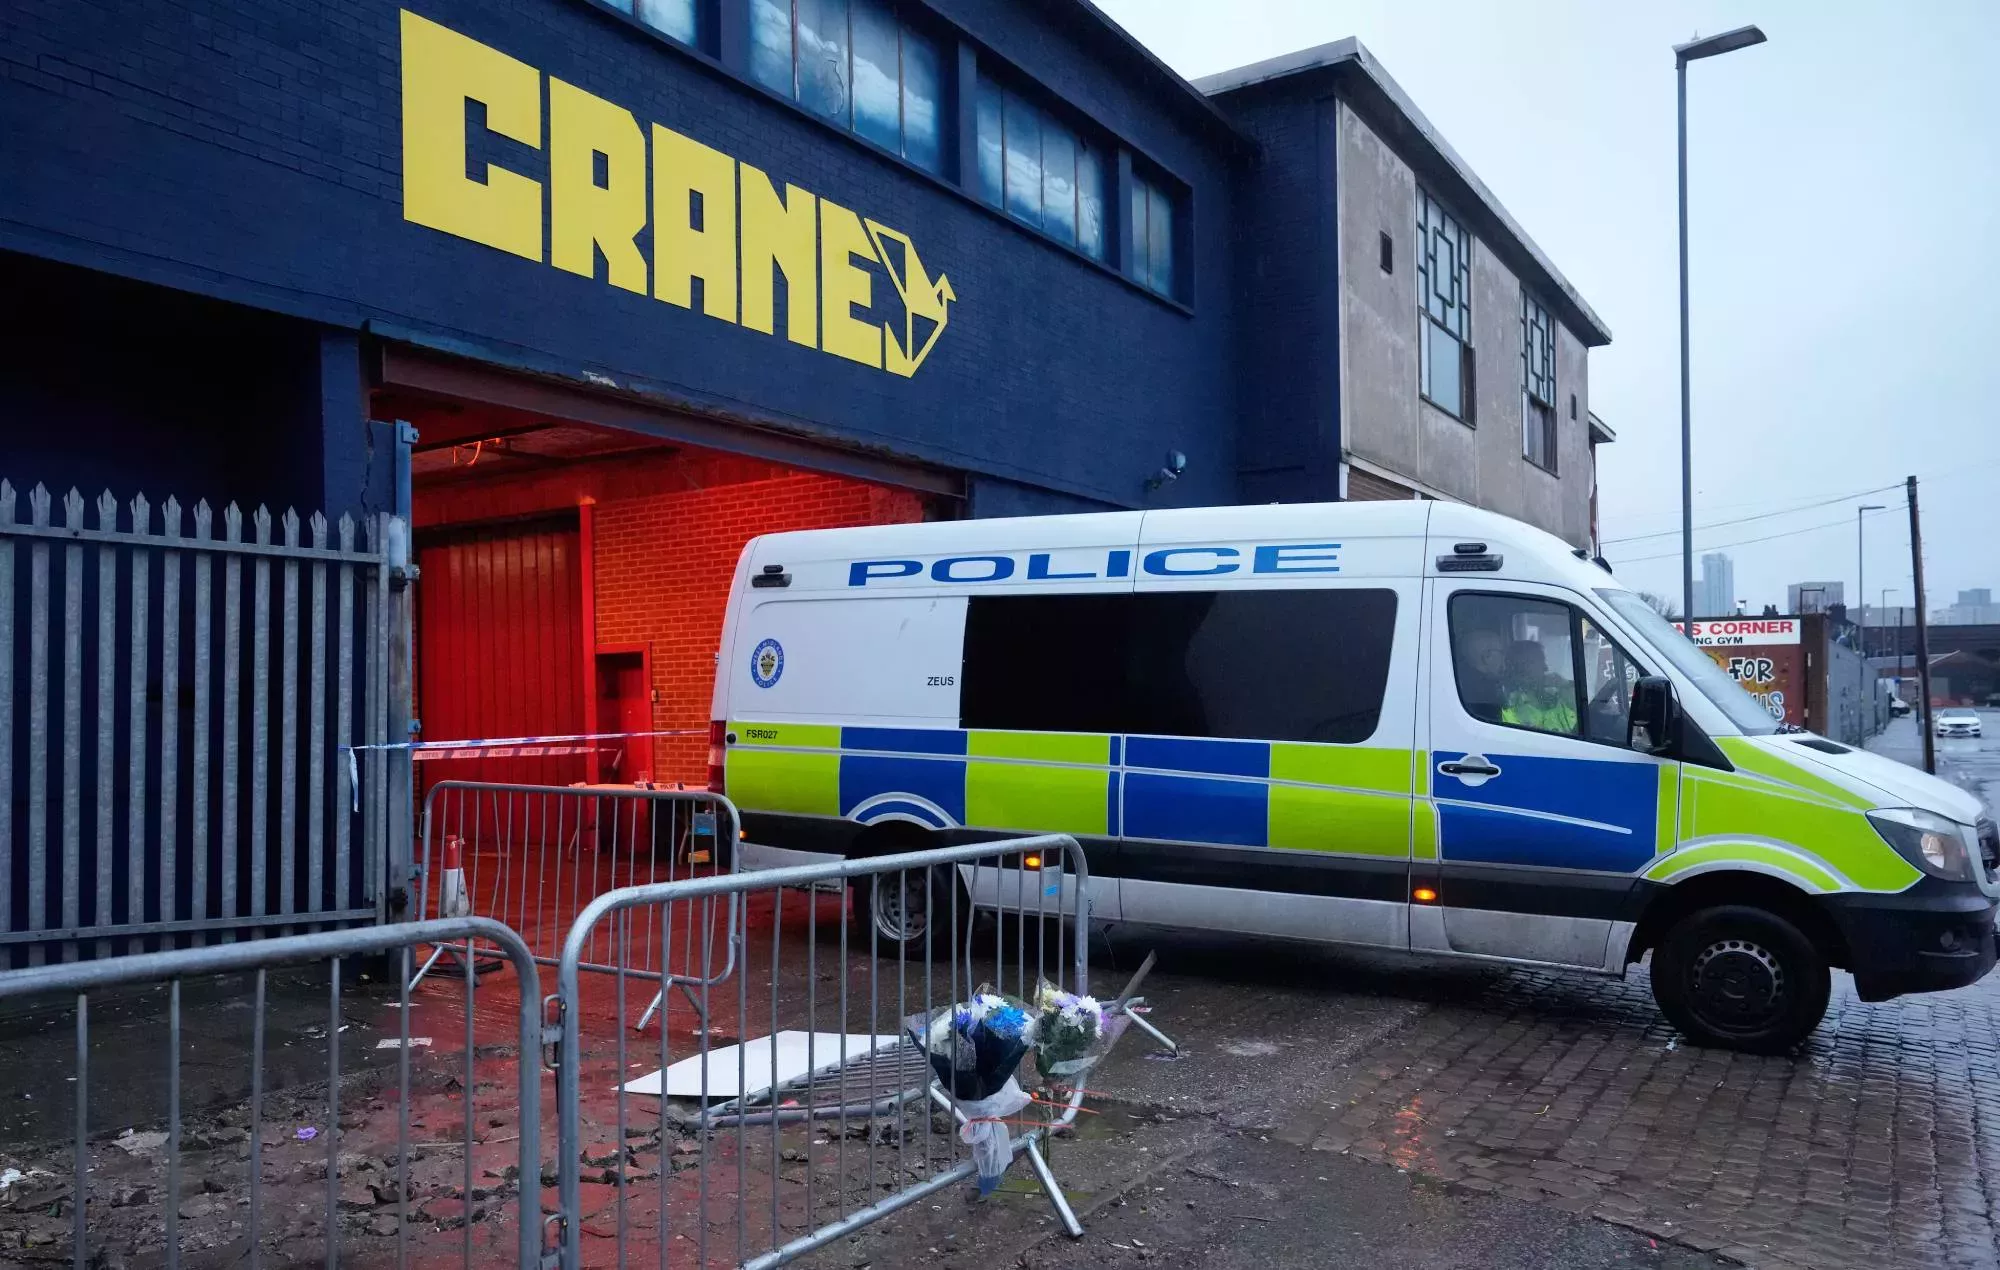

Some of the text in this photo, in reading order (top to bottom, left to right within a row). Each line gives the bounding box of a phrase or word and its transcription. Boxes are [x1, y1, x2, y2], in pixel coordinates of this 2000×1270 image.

[400, 8, 882, 369] CRANE
[848, 543, 1342, 586] POLICE
[1709, 621, 1793, 635] CORNER
[1717, 636, 1743, 645] GYM
[1728, 657, 1775, 683] FOR
[755, 676, 778, 688] POLICE
[927, 676, 954, 686] ZEUS
[746, 729, 778, 739] FSR027
